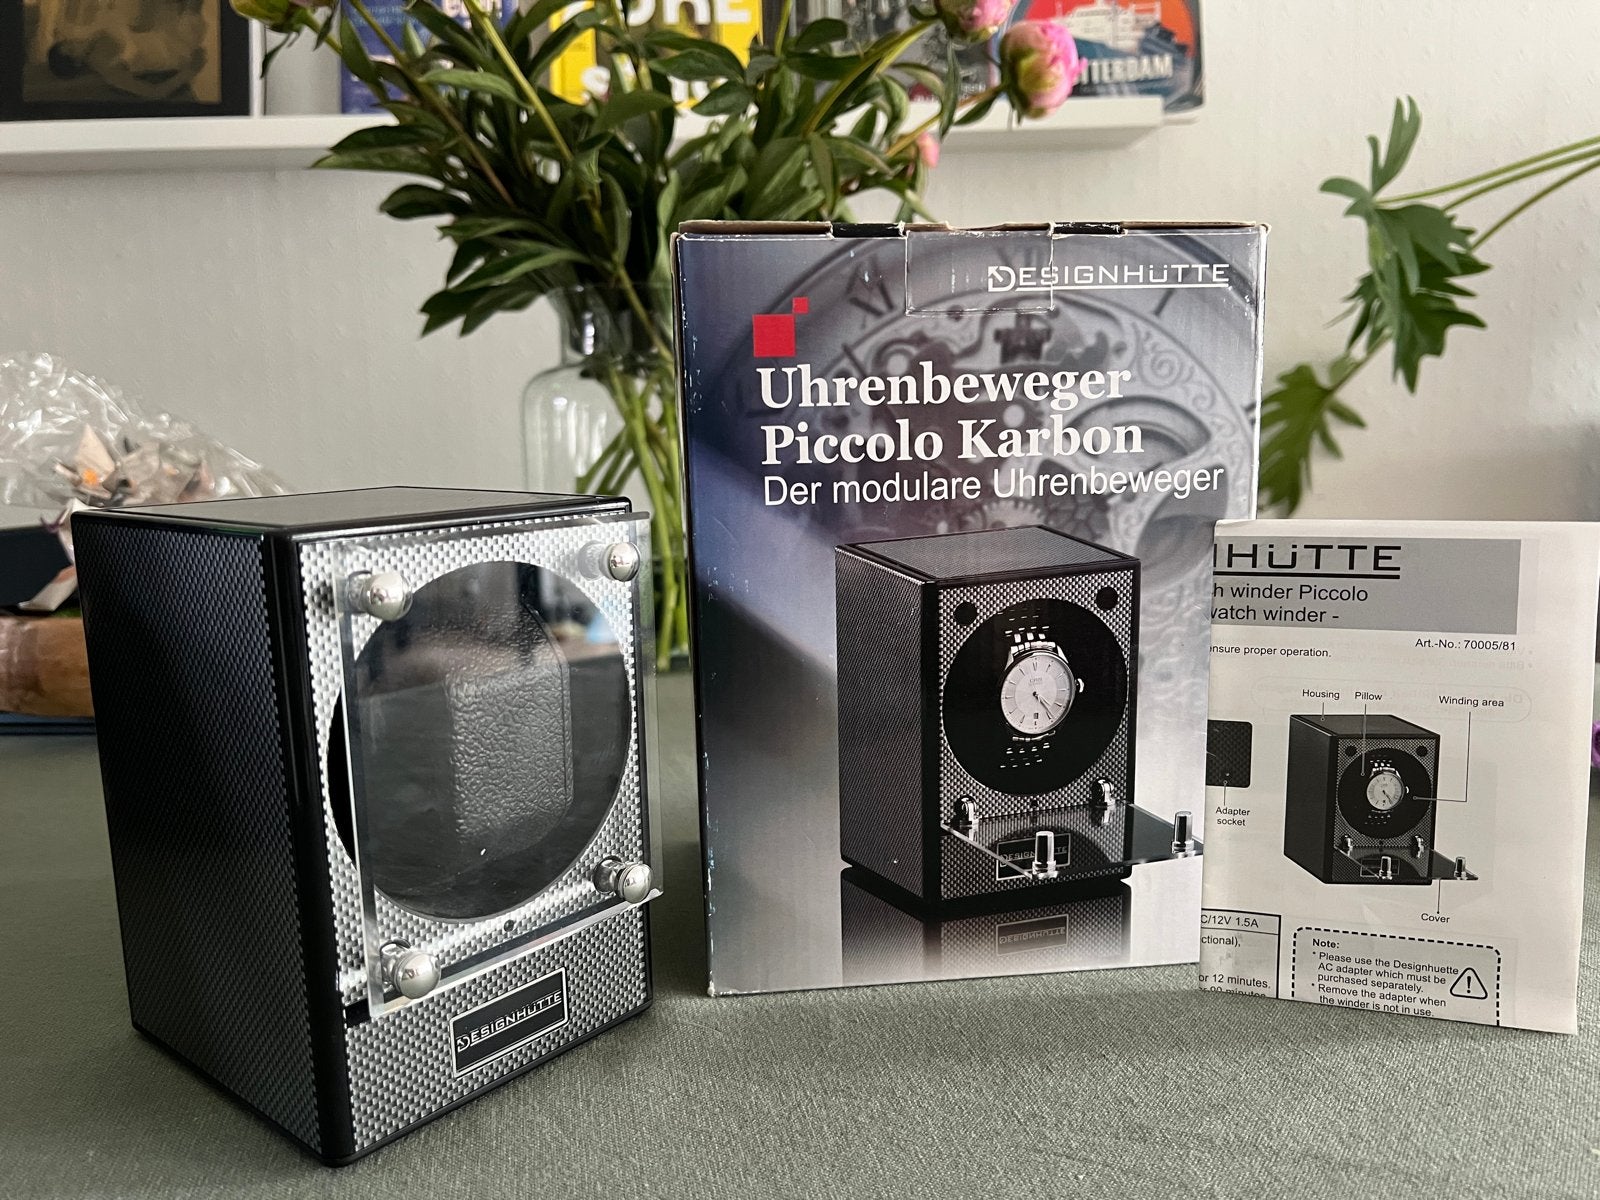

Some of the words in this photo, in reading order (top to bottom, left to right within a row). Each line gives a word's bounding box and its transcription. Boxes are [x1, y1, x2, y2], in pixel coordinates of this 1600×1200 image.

[1079, 53, 1173, 85] TTERDAM
[756, 360, 1132, 409] Uhrenbeweger
[760, 419, 943, 465] Piccolo
[958, 414, 1145, 461] Karbon
[764, 475, 822, 506] Der
[832, 471, 981, 504] modulare
[993, 466, 1224, 500] Uhrenbeweger
[1213, 543, 1401, 571] HÜTTE
[1230, 583, 1293, 600] winder
[1300, 584, 1368, 602] Piccolo
[1263, 606, 1327, 623] winder
[1243, 646, 1276, 656] proper
[1280, 647, 1332, 658] operation.
[1415, 637, 1461, 649] Art.-No.:
[1463, 639, 1516, 651] 70005/81
[1302, 689, 1340, 701] Housing
[1354, 691, 1383, 701] Pillow
[1438, 695, 1479, 708] Winding
[1482, 699, 1505, 708] area
[1215, 806, 1250, 818] Adapter
[1217, 817, 1246, 827] socket
[1201, 914, 1232, 925] C/12V
[1235, 917, 1259, 928] 1.5A
[1420, 912, 1451, 924] Cover
[1201, 935, 1241, 948] ctional),
[1312, 938, 1340, 949] Note:
[1319, 951, 1352, 963] Please
[1354, 957, 1372, 965] use
[1375, 958, 1390, 967] the
[1393, 960, 1459, 975] Designhuette
[1199, 974, 1209, 982] or
[1212, 973, 1224, 983] 12
[1227, 975, 1271, 989] minutes.
[1318, 962, 1333, 971] AC
[1336, 965, 1373, 976] adapter
[1375, 969, 1404, 979] which
[1406, 973, 1431, 983] must
[1433, 975, 1446, 984] be
[1317, 973, 1368, 986] purchased
[1370, 979, 1424, 994] separately.
[1318, 984, 1358, 996] Remove
[1361, 989, 1376, 998] the
[1379, 992, 1417, 1003] adapter
[1419, 996, 1447, 1007] when
[1319, 995, 1335, 1005] the
[1337, 997, 1370, 1008] winder
[1372, 1000, 1381, 1010] is
[1383, 1004, 1400, 1012] not
[1401, 1005, 1411, 1014] in
[1413, 1008, 1435, 1017] use.
[456, 990, 562, 1053] DESIGNHÜTTE
